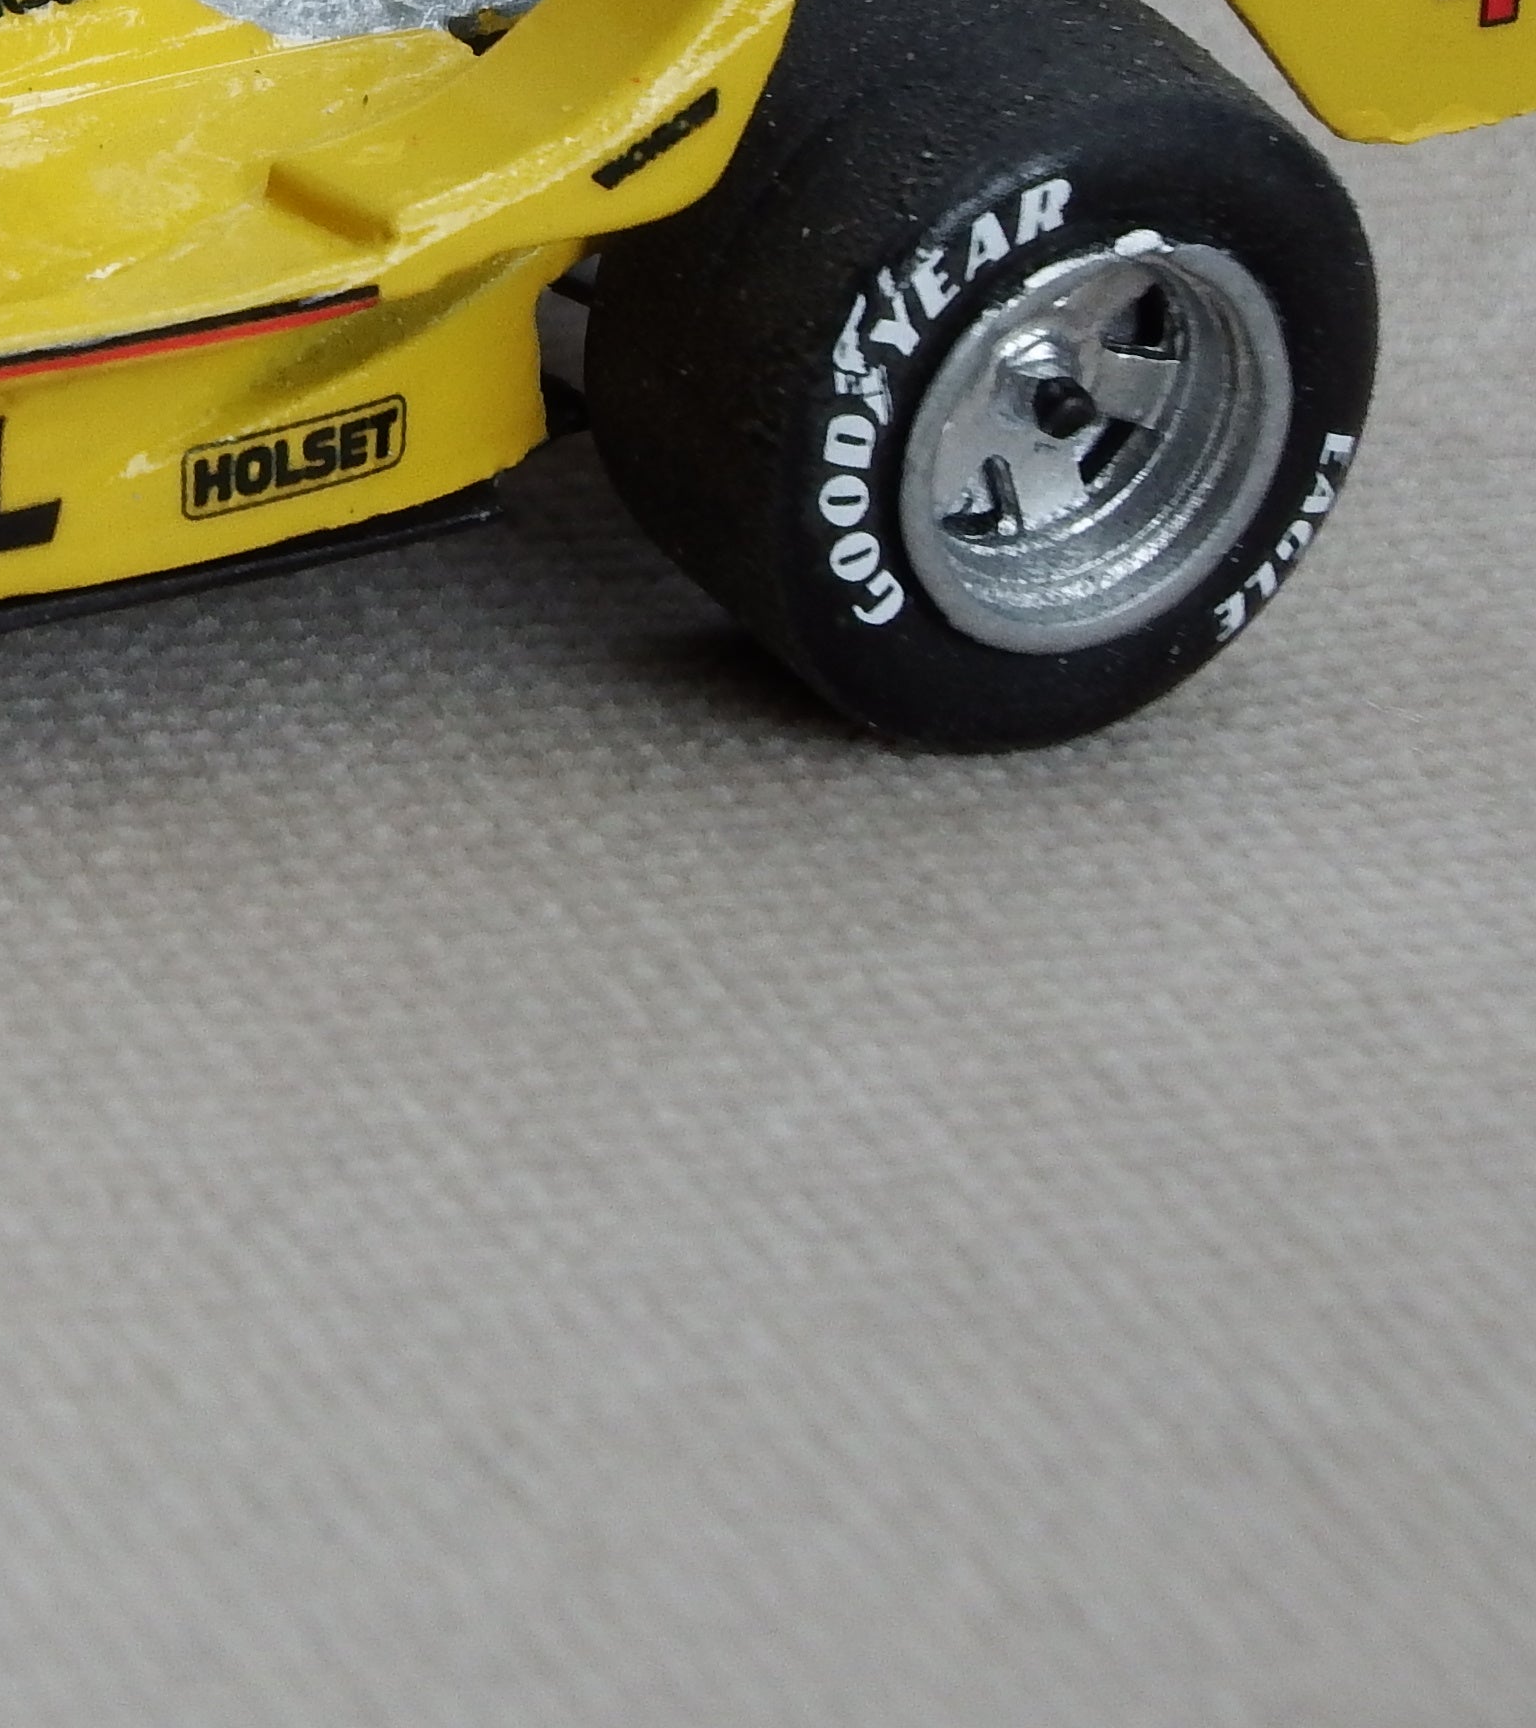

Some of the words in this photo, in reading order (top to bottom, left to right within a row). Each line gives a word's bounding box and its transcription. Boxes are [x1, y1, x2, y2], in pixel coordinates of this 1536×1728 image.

[194, 407, 398, 506] HOLSET
[818, 178, 1074, 627] GOODYEAR
[1214, 432, 1358, 642] EAGLE
